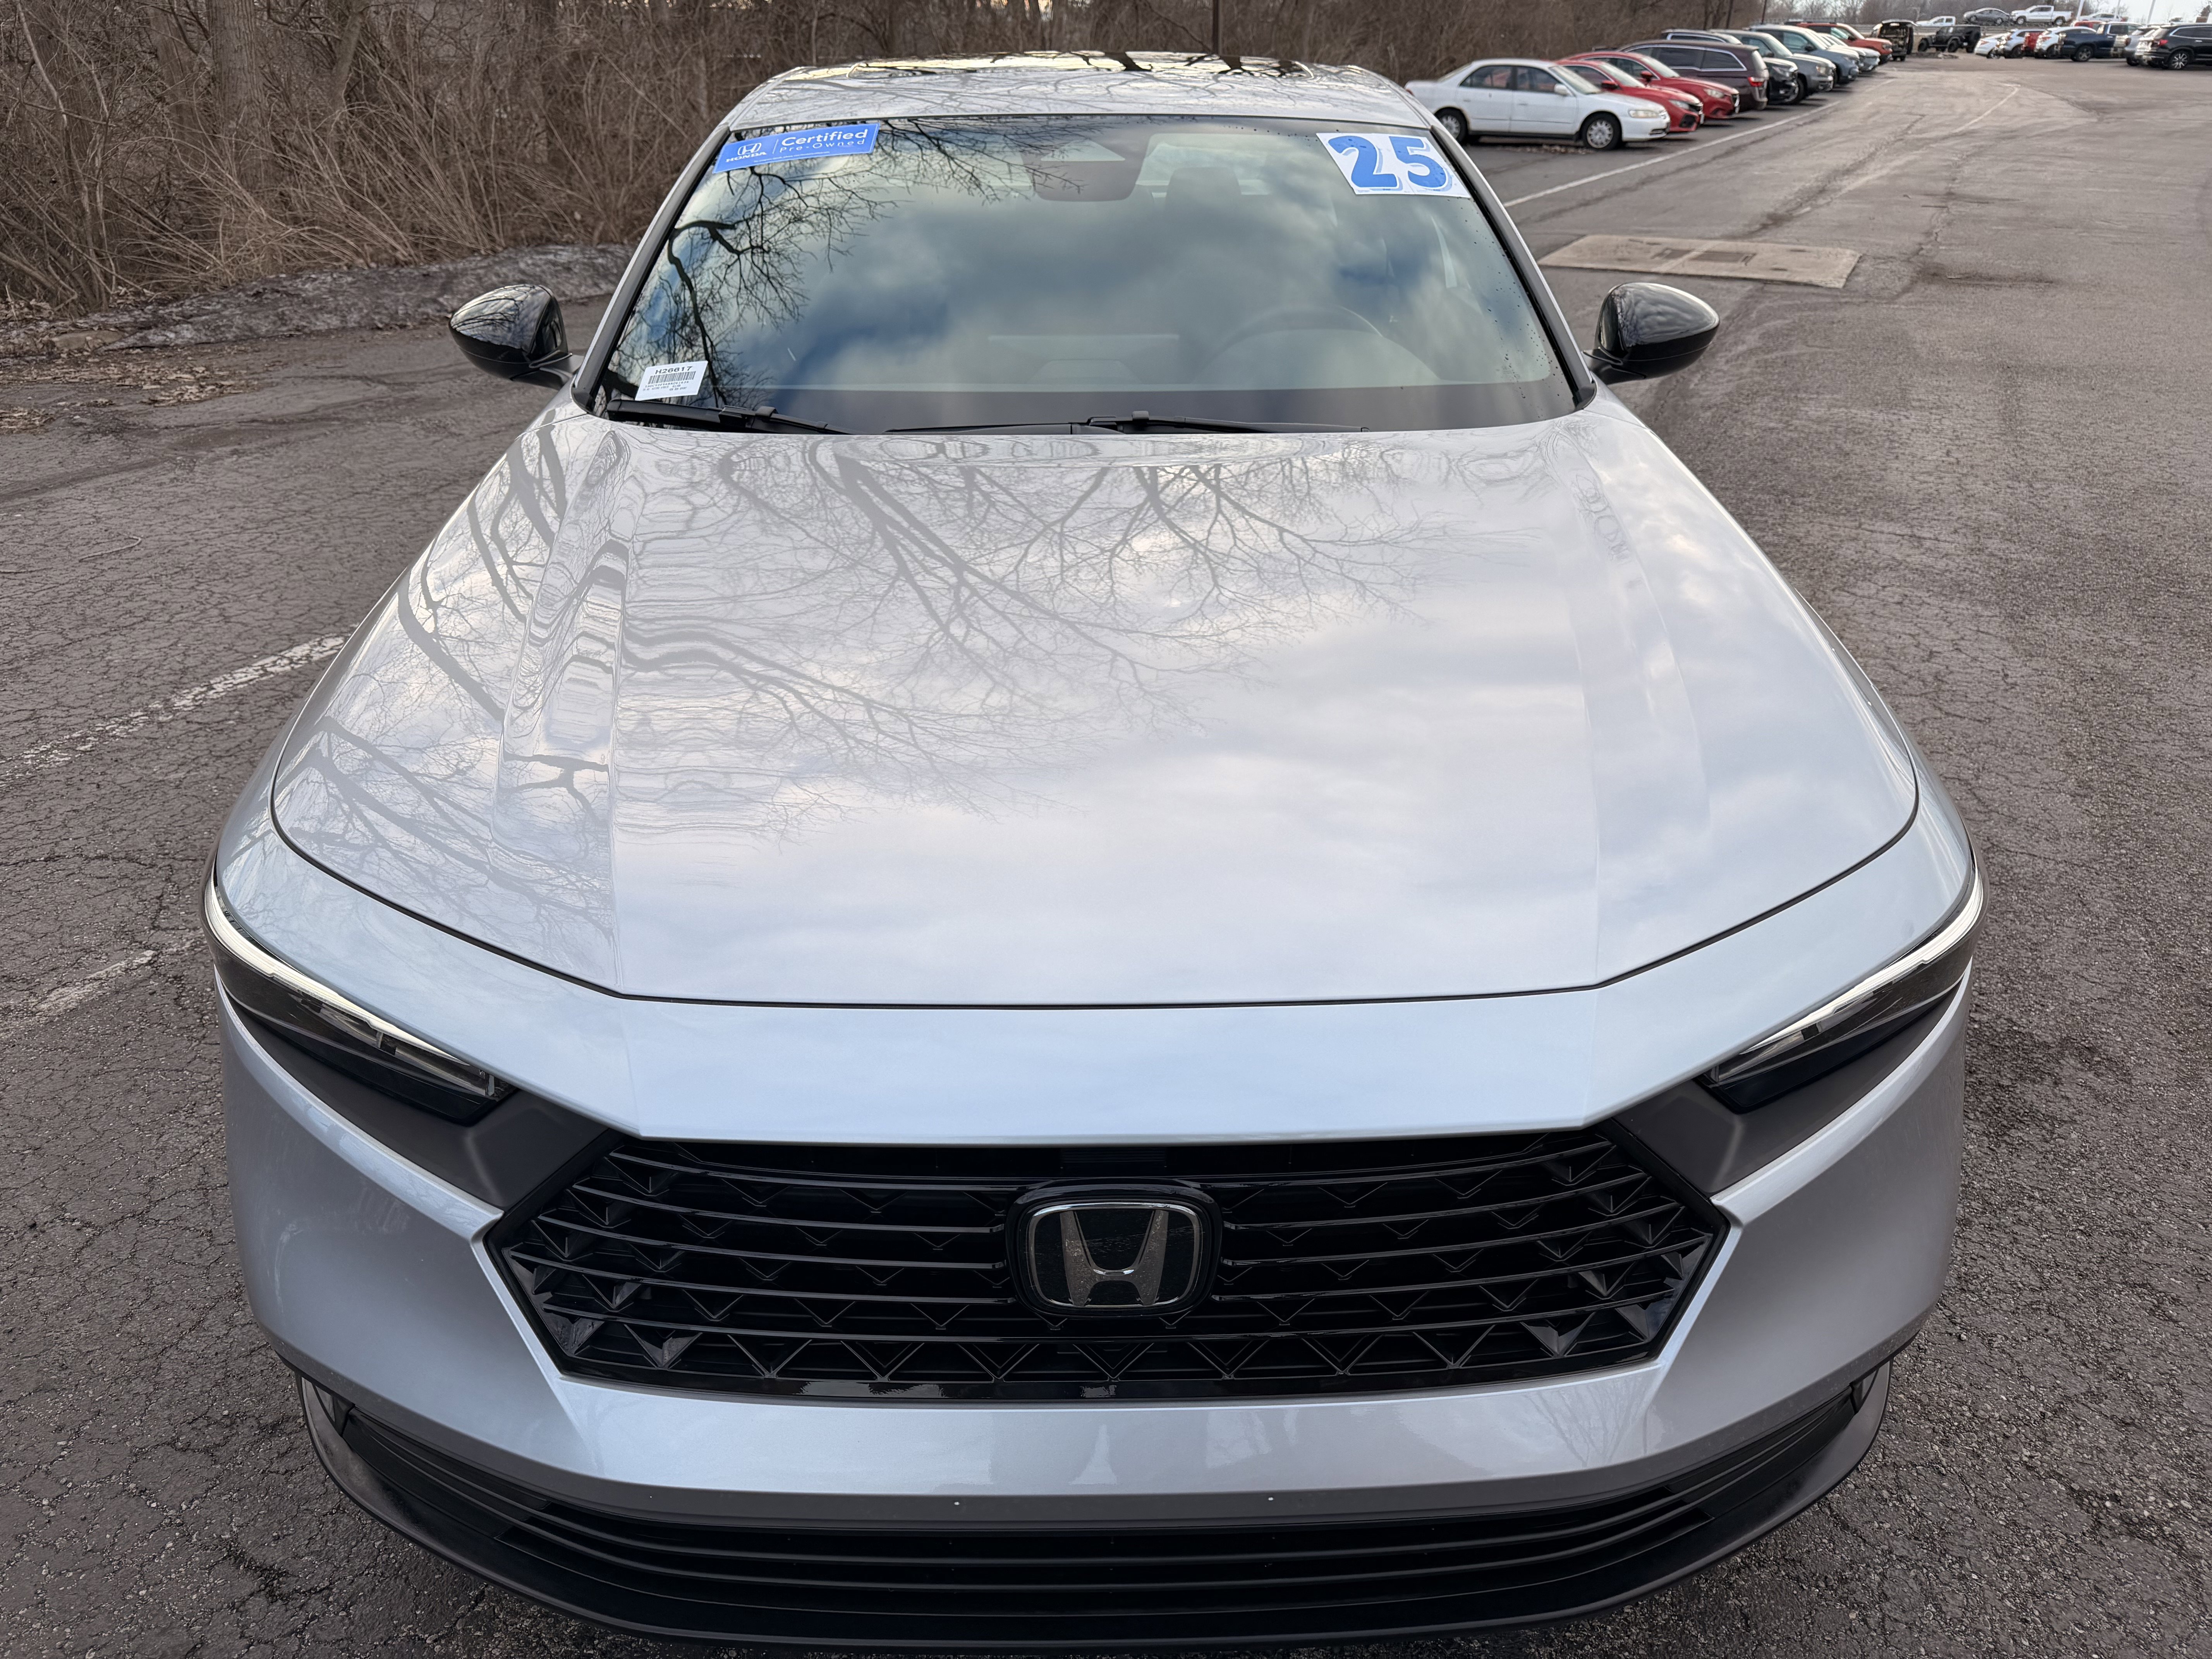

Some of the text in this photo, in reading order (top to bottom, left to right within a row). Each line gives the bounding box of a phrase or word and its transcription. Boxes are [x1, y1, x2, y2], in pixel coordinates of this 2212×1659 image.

[781, 129, 868, 146] Certified
[780, 138, 865, 153] Pre-Owned
[726, 151, 767, 162] HONDA
[1328, 136, 1448, 188] 25
[655, 366, 693, 374] H26617
